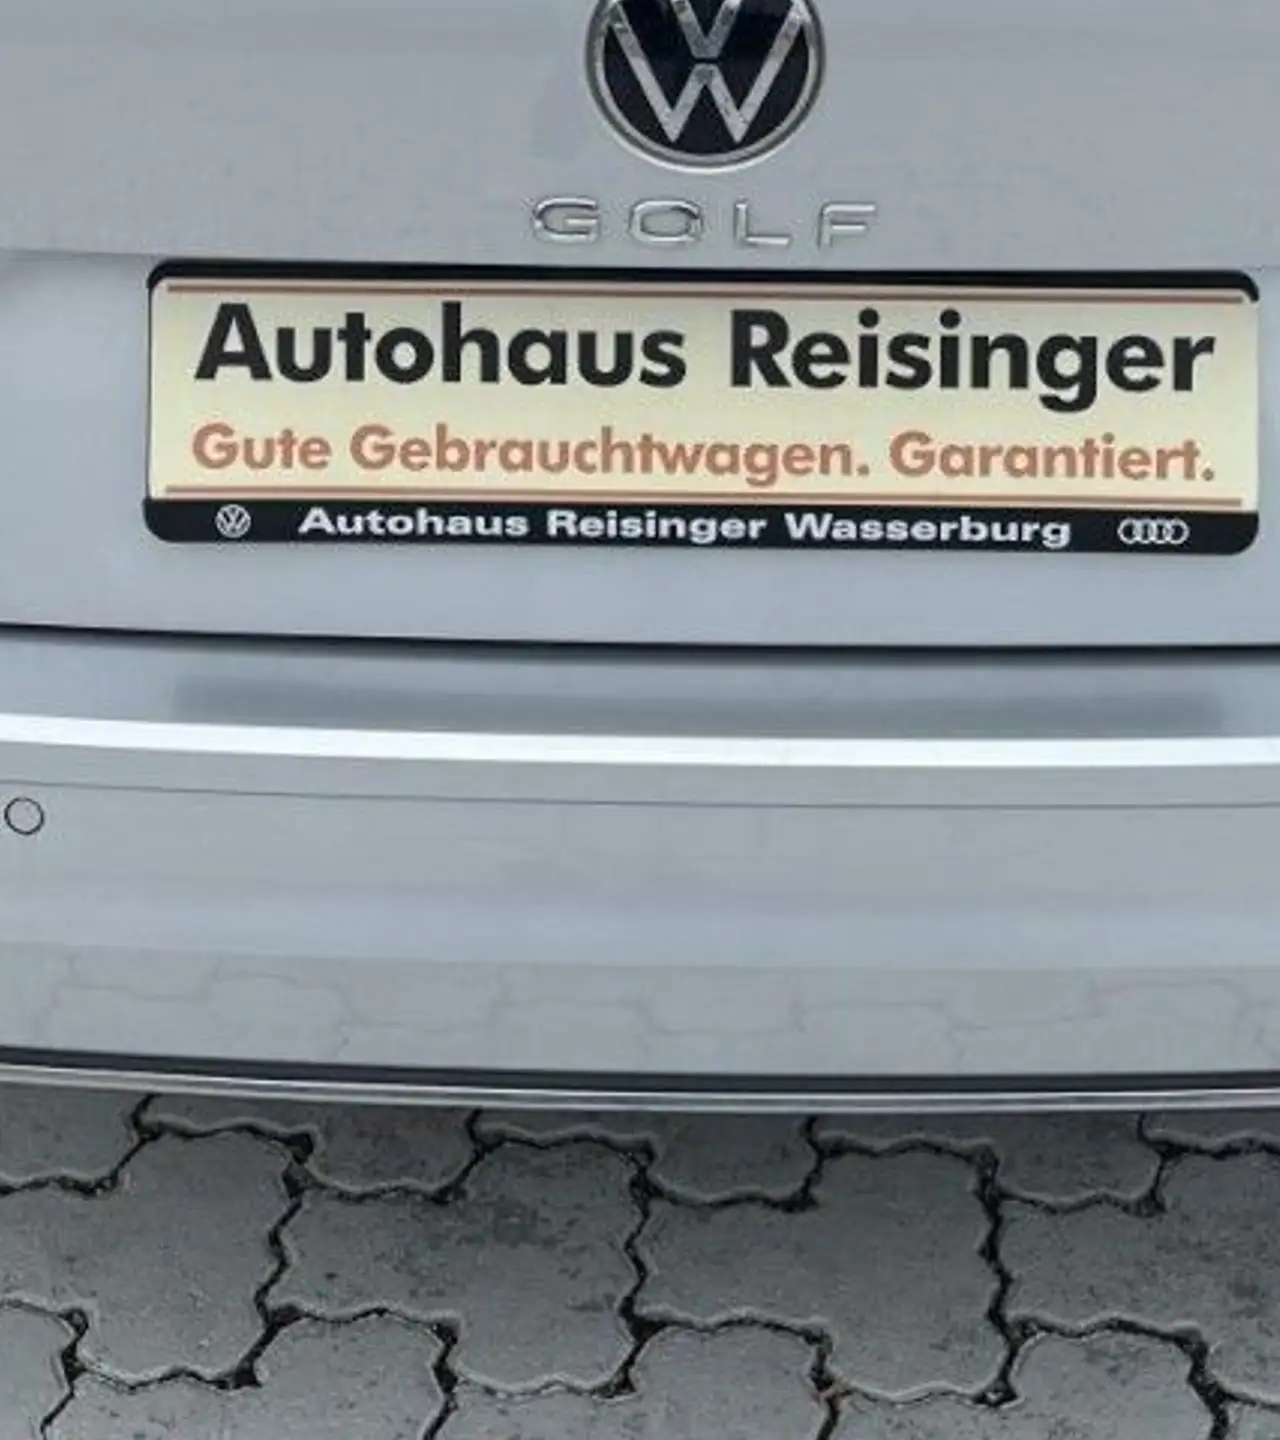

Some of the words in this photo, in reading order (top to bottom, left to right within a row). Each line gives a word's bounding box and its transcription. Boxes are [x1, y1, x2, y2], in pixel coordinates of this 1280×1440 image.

[533, 195, 878, 250] GOLF
[193, 300, 689, 389] Autohaus
[729, 307, 1217, 414] Reisinger
[191, 421, 332, 472] Gute
[348, 423, 871, 487] Gebrauchtwagen.
[887, 430, 1216, 482] Garantiert.
[297, 506, 528, 538] Autohaus
[546, 509, 768, 545] Reisinger
[783, 511, 1072, 549] Wasserburg
